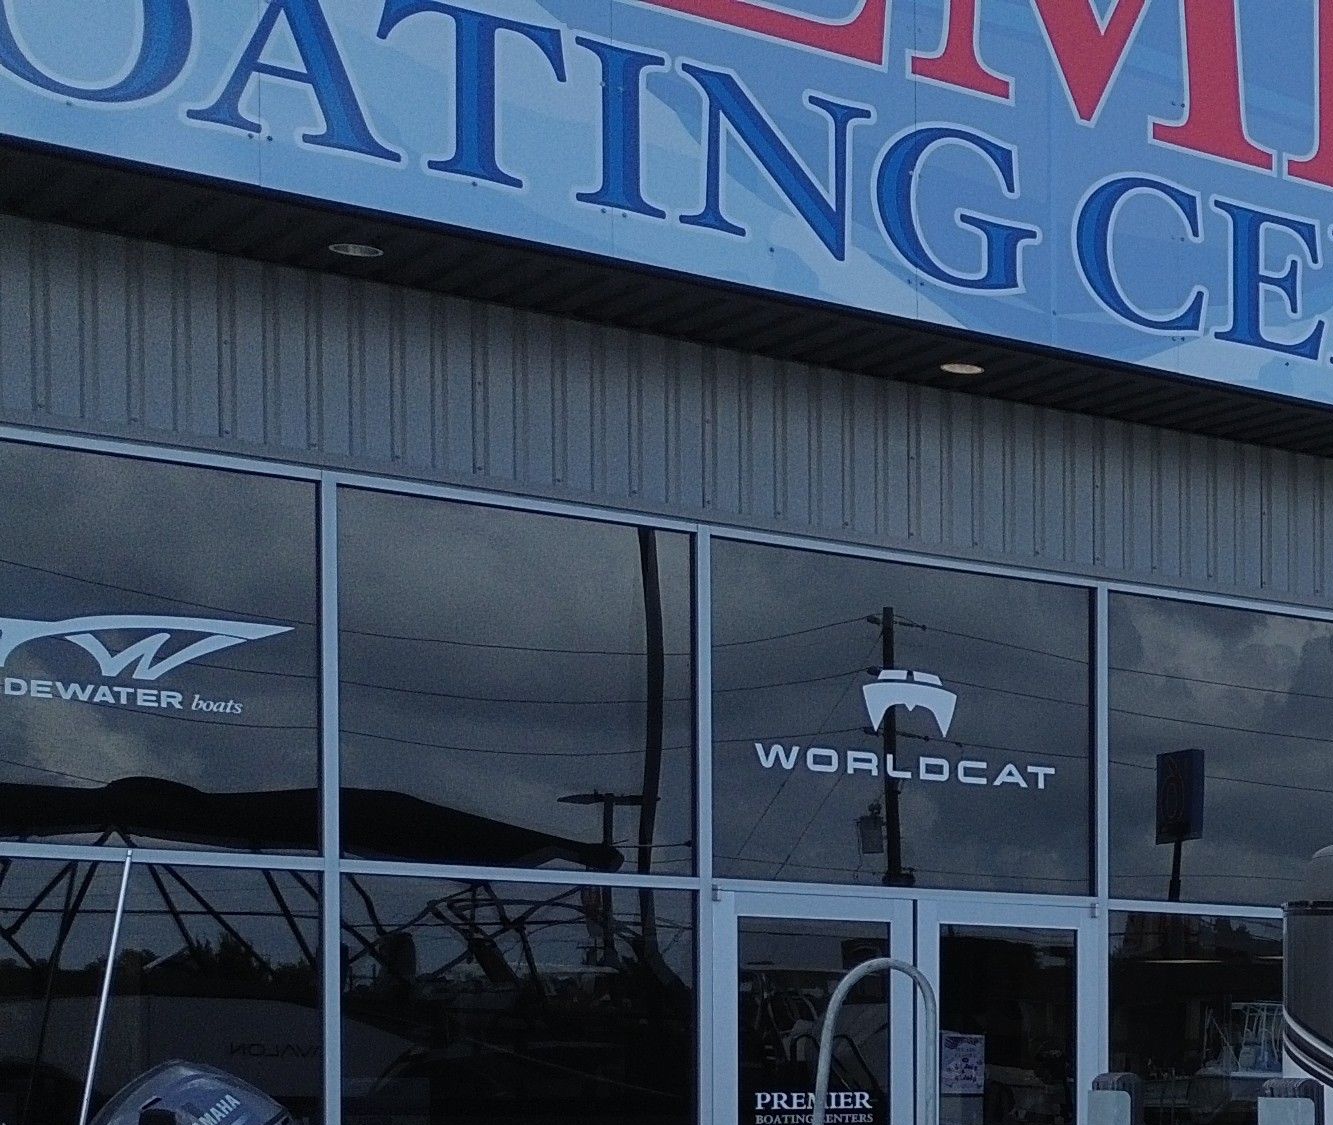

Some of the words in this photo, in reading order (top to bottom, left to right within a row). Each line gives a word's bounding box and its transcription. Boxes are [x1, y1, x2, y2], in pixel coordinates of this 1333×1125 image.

[191, 694, 244, 714] boats
[754, 743, 1056, 789] WORLDCAT
[825, 1113, 874, 1123] ENTERS
